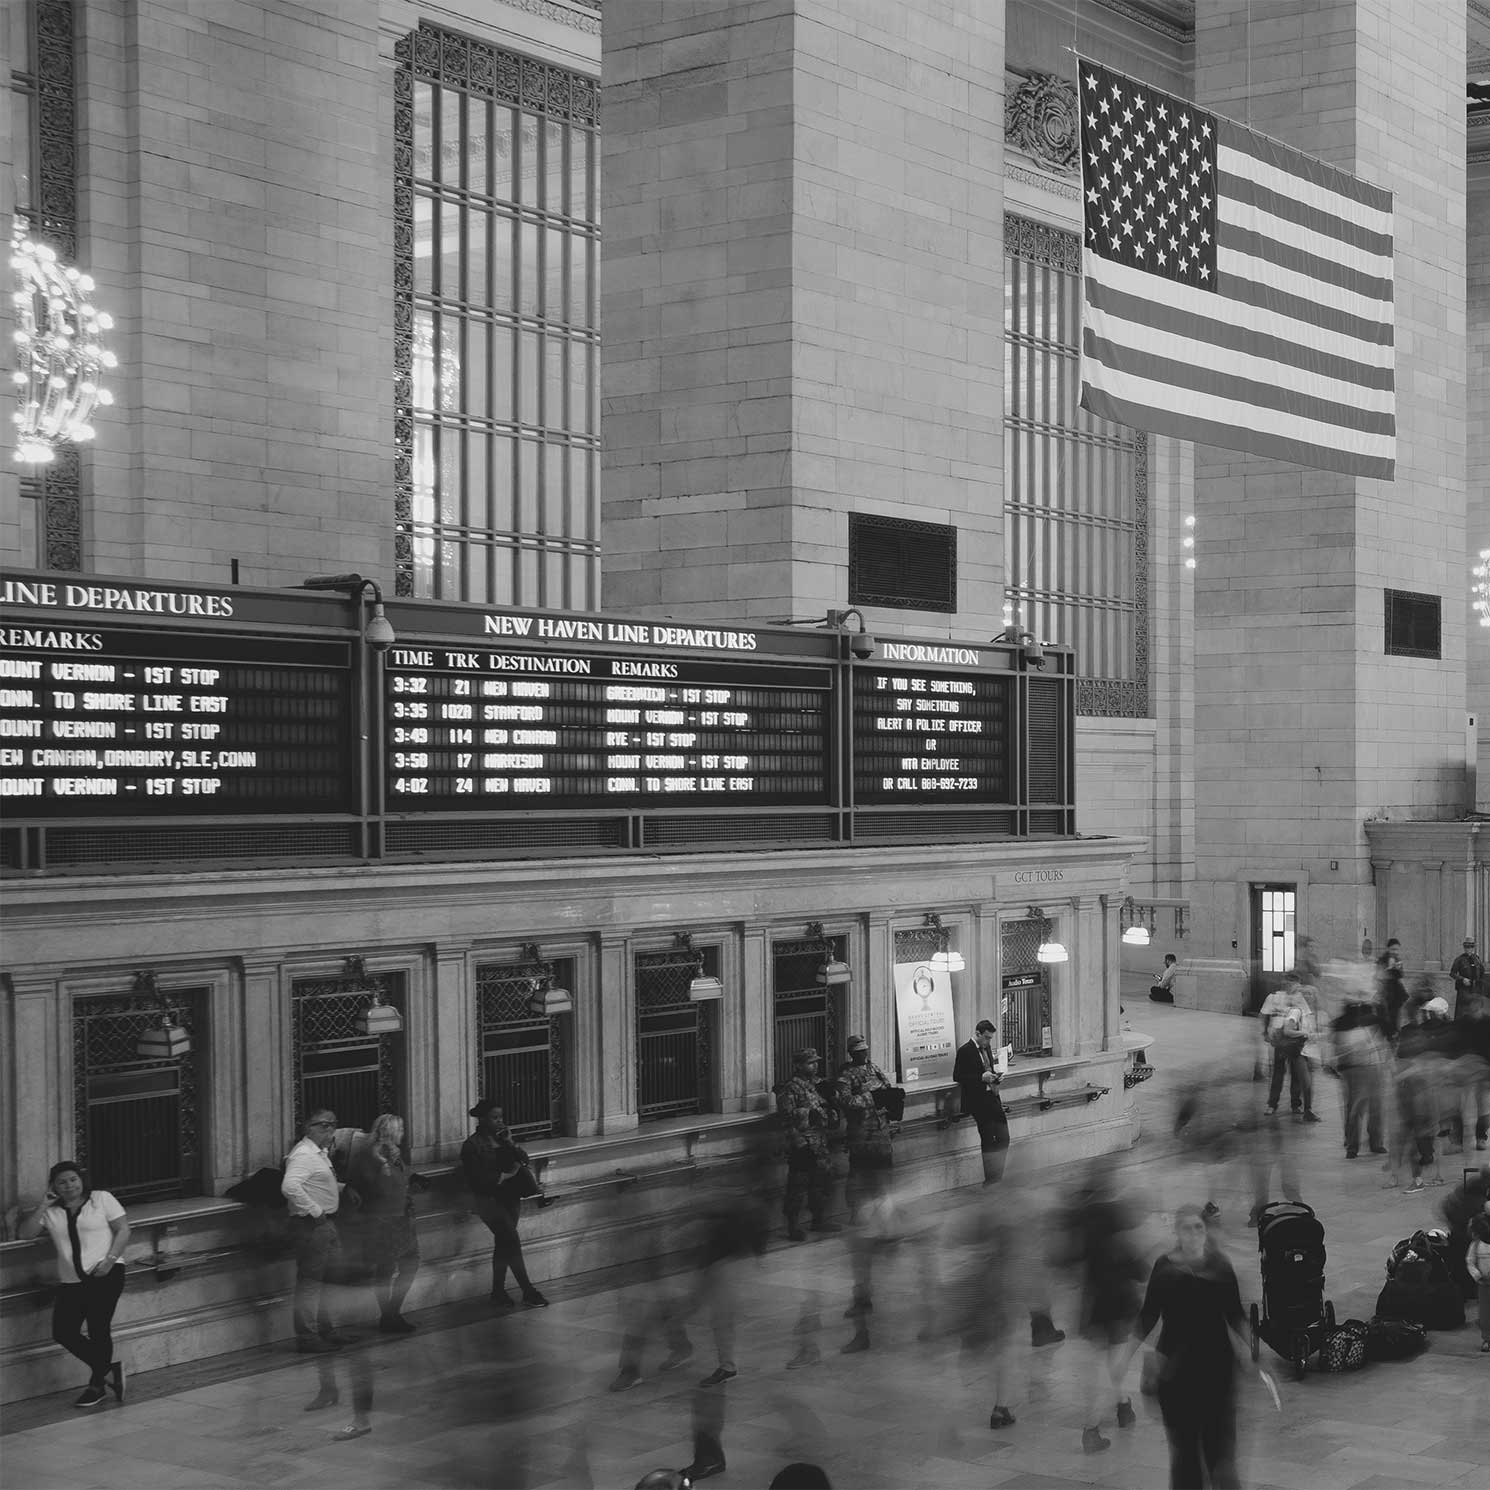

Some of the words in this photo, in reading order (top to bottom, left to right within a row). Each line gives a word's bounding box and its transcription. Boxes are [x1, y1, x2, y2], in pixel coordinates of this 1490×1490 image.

[66, 585, 234, 616] DEPARTURES
[0, 628, 103, 650] REMARKS
[484, 615, 533, 636] NEW
[538, 618, 603, 641] HAVEN
[608, 623, 649, 644] LINE
[653, 626, 757, 650] DEPARTURES
[883, 643, 979, 665] INFORMATION
[392, 649, 434, 667] TIME
[445, 652, 480, 669] TRK
[489, 654, 591, 674] DESTINATION
[611, 661, 678, 678] REMARKS
[51, 663, 116, 682] VERNON
[144, 667, 174, 684] 1ST
[180, 667, 220, 686] STOP
[393, 677, 427, 693] 3:32
[454, 680, 470, 695] 21
[483, 680, 508, 696] NEW
[512, 682, 550, 698] HAVEN
[876, 677, 888, 689] IF
[892, 677, 908, 690] YOU
[911, 678, 927, 692] SEE
[930, 680, 976, 696] SOMETHING,
[53, 691, 75, 709] TO
[83, 692, 135, 711] SHORE
[143, 694, 183, 712] LINE
[190, 696, 229, 713] EAST
[682, 688, 701, 703] 1ST
[705, 689, 731, 704] STOP
[394, 703, 428, 719] 3:35
[896, 698, 912, 711] SAY
[916, 699, 960, 713] SOMETHING
[606, 708, 641, 724] MOUNT
[645, 710, 684, 725] VERNON
[701, 711, 720, 726] 1ST
[722, 712, 748, 727] STOP
[877, 717, 903, 730] ALERT
[906, 718, 913, 731] A
[916, 718, 946, 732] POLICE
[949, 720, 982, 733] OFFICER
[53, 720, 116, 738] VERNON
[145, 722, 174, 739] 1ST
[181, 723, 220, 740] STOP
[394, 728, 428, 744] 3:49
[449, 728, 473, 744] 114
[484, 729, 508, 744] NEW
[512, 730, 557, 745] CANAAN
[606, 732, 628, 746] RYE
[646, 732, 666, 746] 1ST
[669, 732, 696, 747] STOP
[925, 738, 937, 751] OR
[456, 753, 473, 768] 17
[484, 754, 543, 769] HARRISON
[607, 755, 641, 769] MOUNT
[645, 755, 684, 769] VERNON
[701, 755, 720, 769] 1ST
[723, 756, 749, 770] STOP
[902, 758, 918, 770] MTA
[921, 758, 960, 770] EMPLOYEE
[53, 778, 118, 796] VERNON
[146, 778, 175, 795] 1ST
[182, 778, 221, 795] STOP
[395, 778, 428, 793] 4:02
[456, 778, 473, 793] 24
[484, 778, 509, 793] NEW
[513, 778, 551, 793] HAVEN
[607, 777, 640, 792] CONN.
[646, 777, 660, 792] TO
[664, 777, 697, 791] SHORE
[700, 777, 726, 791] LINE
[729, 777, 754, 791] EAST
[883, 777, 894, 790] OR
[897, 777, 918, 790] CALL
[1014, 871, 1034, 883] GCT
[1034, 870, 1064, 882] TOURS
